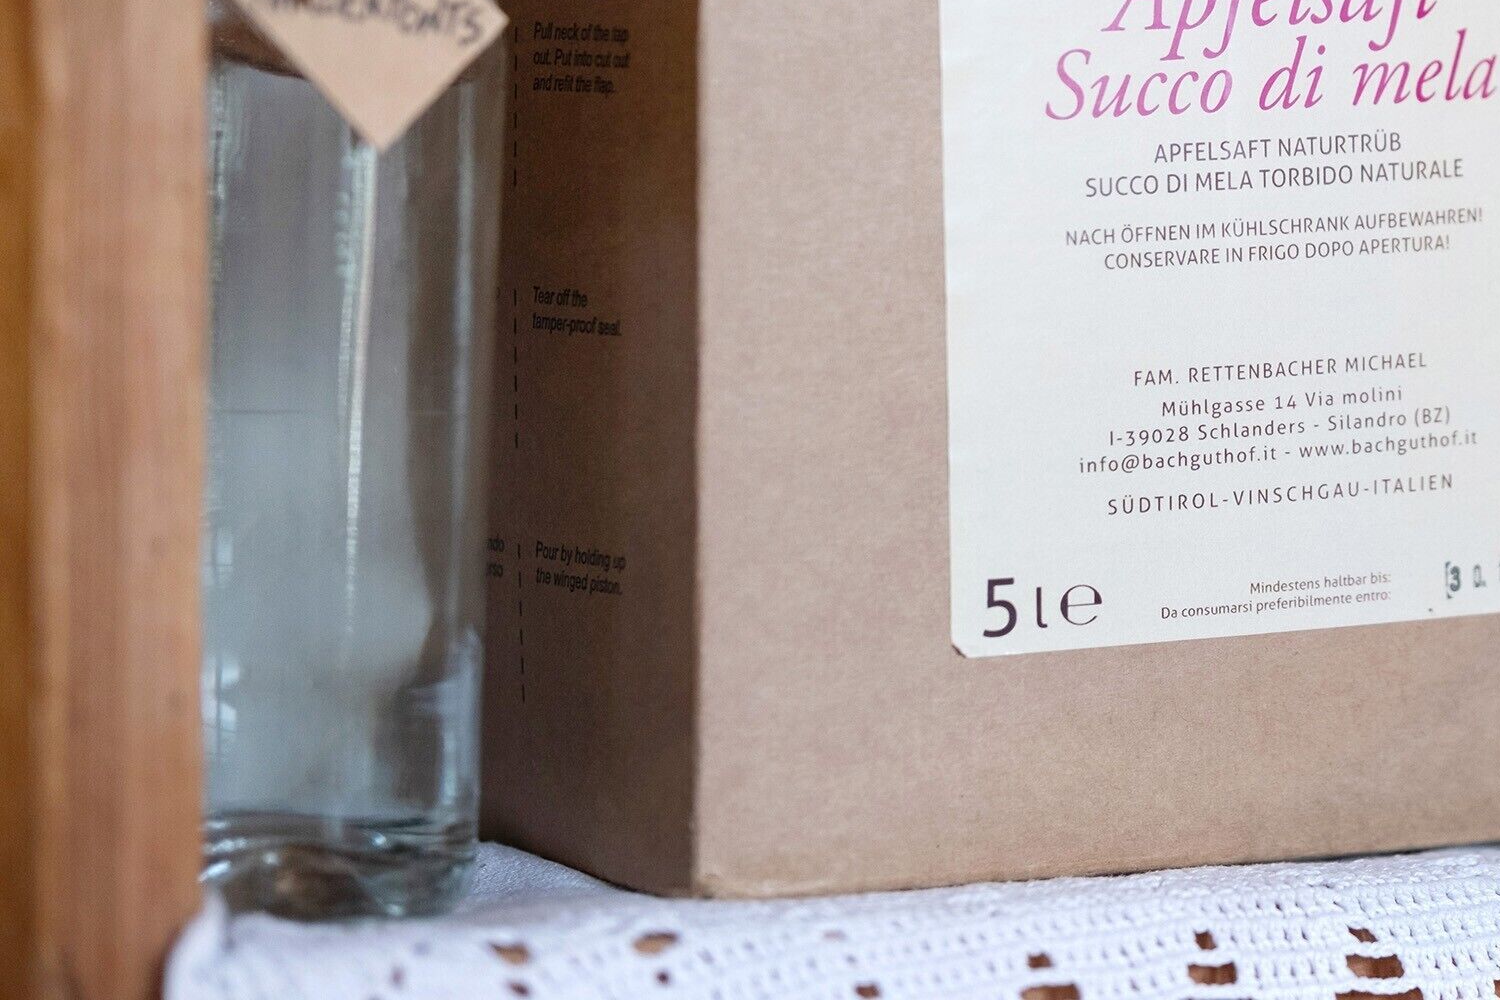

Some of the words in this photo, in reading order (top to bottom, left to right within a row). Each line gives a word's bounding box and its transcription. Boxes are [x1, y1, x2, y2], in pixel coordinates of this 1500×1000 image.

[533, 22, 553, 41] Pull
[554, 23, 580, 42] neck
[553, 49, 572, 67] Put
[1045, 48, 1233, 121] Succo
[1258, 36, 1327, 113] di
[1351, 28, 1498, 108] mela
[533, 74, 553, 92] and
[575, 76, 592, 93] the
[1153, 138, 1270, 163] APFELSAFT
[1278, 131, 1402, 158] NATURTRÜB
[1085, 174, 1159, 198] SUCCO
[1166, 173, 1188, 193] DI
[1195, 169, 1254, 192] MELA
[1259, 164, 1353, 188] TORBIDO
[1360, 158, 1464, 183] NATURALE
[1065, 227, 1116, 247] NACH
[1120, 222, 1192, 244] ÖFFNEN
[1196, 222, 1216, 239] IM
[1221, 214, 1350, 238] KÜHLSCHRANK
[1353, 207, 1483, 231] AUFBEWAHREN!
[1104, 247, 1220, 271] CONSERVARE
[1225, 246, 1243, 263] IN
[1248, 242, 1300, 262] FRIGO
[1305, 240, 1354, 260] DOPO
[1359, 235, 1450, 256] APERTURA!
[533, 286, 554, 305] Tear
[556, 289, 571, 306] off
[571, 290, 588, 308] the
[532, 312, 597, 336] tamper-proof
[1133, 369, 1180, 387] FAM.
[1188, 358, 1337, 384] RETTENBACHER
[1345, 353, 1427, 374] MICHAEL
[1162, 396, 1265, 419] Mühlgasse
[1275, 395, 1298, 411] 14
[1305, 391, 1334, 407] Via
[1342, 385, 1402, 404] molini
[1109, 425, 1190, 447] I-39028
[1197, 418, 1305, 441] Schlanders
[1327, 411, 1407, 433] Silandro
[1413, 406, 1451, 427] (BZ)
[1079, 445, 1277, 474] info@bachguthof.it
[1299, 430, 1478, 459] www.bachguthof.it
[1107, 473, 1454, 516] SÜDTIROL-VINSCHGAU-ITALIEN
[536, 540, 559, 561] Pour
[560, 544, 573, 566] by
[574, 547, 611, 572] holding
[536, 568, 551, 585] the
[553, 570, 589, 593] winged
[1249, 576, 1320, 595] Mindestens
[1324, 573, 1367, 589] haltbar
[1371, 572, 1391, 585] bis:
[983, 577, 1018, 638] 5
[1161, 605, 1178, 619] Da
[1181, 599, 1253, 618] consumarsi
[1256, 592, 1352, 615] preferibilmente
[1355, 590, 1391, 602] entro:
